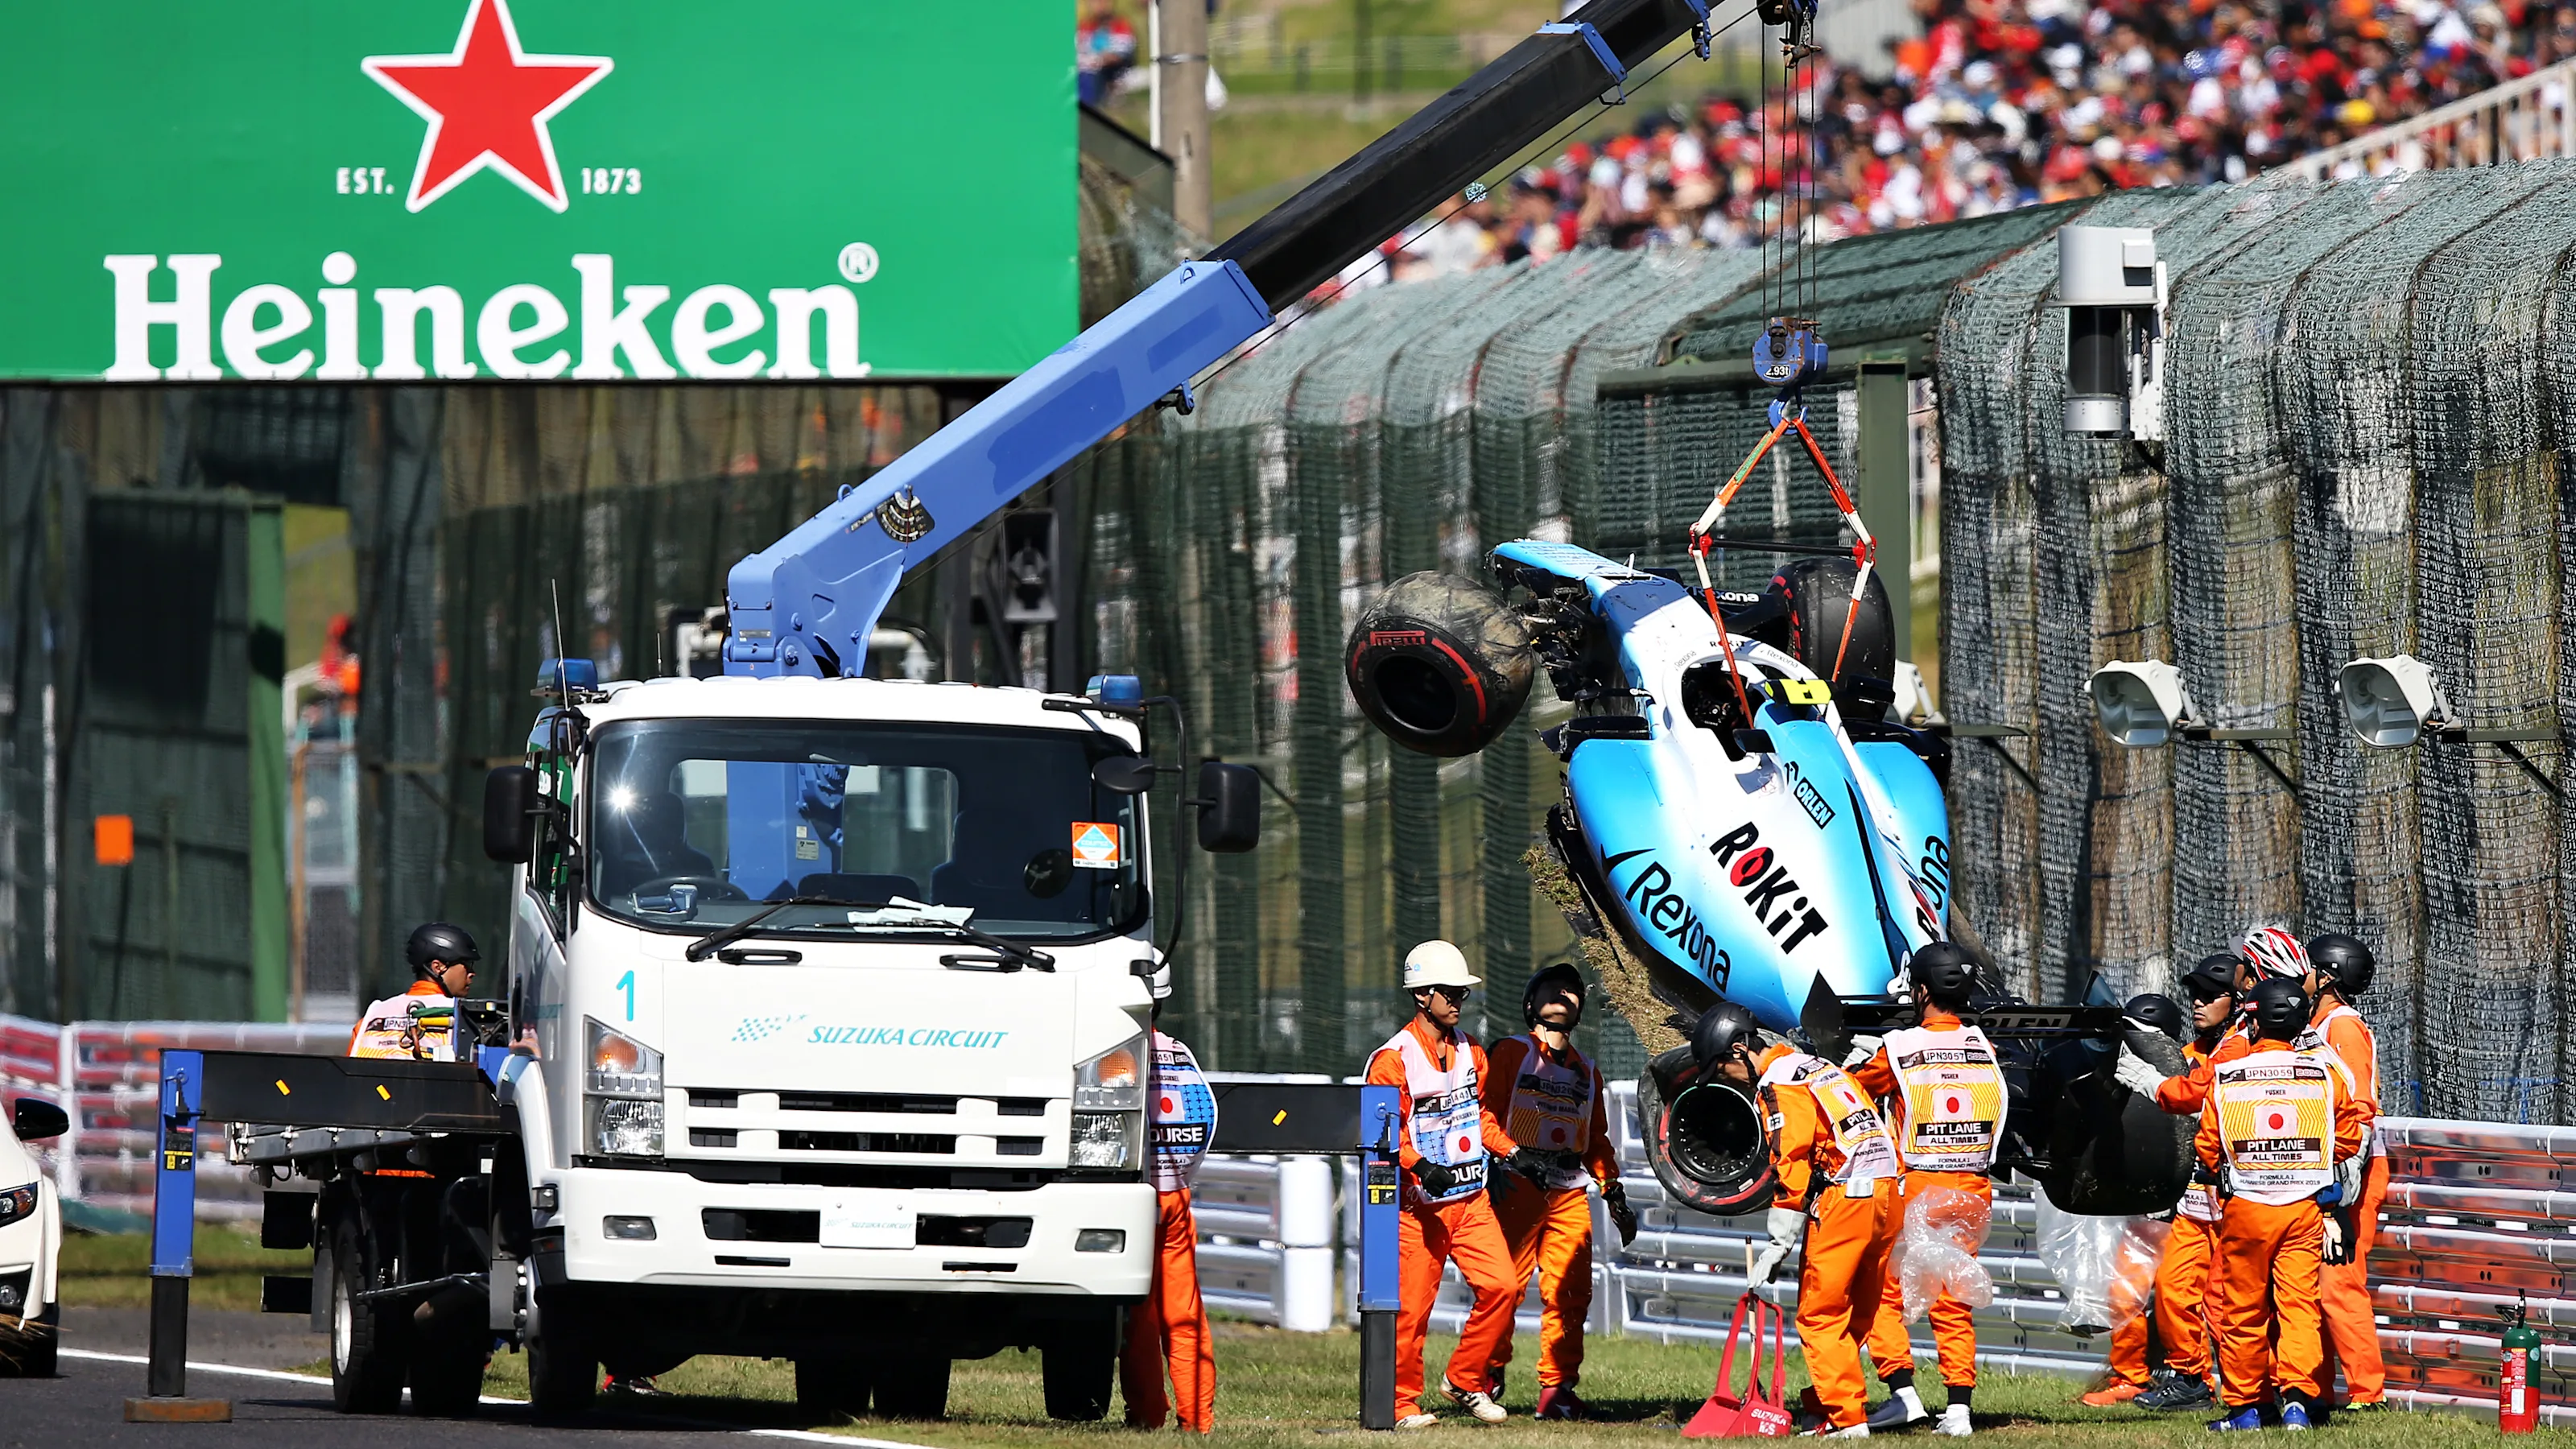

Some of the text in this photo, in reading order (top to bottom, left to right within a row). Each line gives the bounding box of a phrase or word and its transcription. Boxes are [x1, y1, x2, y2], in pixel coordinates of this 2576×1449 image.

[336, 167, 642, 195] EST. 1873
[103, 251, 872, 380] Heineken
[1370, 630, 1426, 646] PIRELLI
[1766, 649, 1799, 669] Rexona
[1797, 782, 1832, 826] ORLEN
[1625, 861, 1731, 993] Rexona
[615, 969, 636, 1022] 1
[807, 1026, 1009, 1049] SUZUKA CIRCUIT
[1925, 1051, 1964, 1062] JPN3057
[2246, 1068, 2293, 1078] JPN3059
[1926, 1123, 1982, 1134] PIT LANE
[1950, 1136, 1979, 1144] TIMES
[2247, 1139, 2306, 1151] PIT LANE
[2272, 1153, 2302, 1161] TIMES
[1751, 1408, 1786, 1426] SUZUKA
